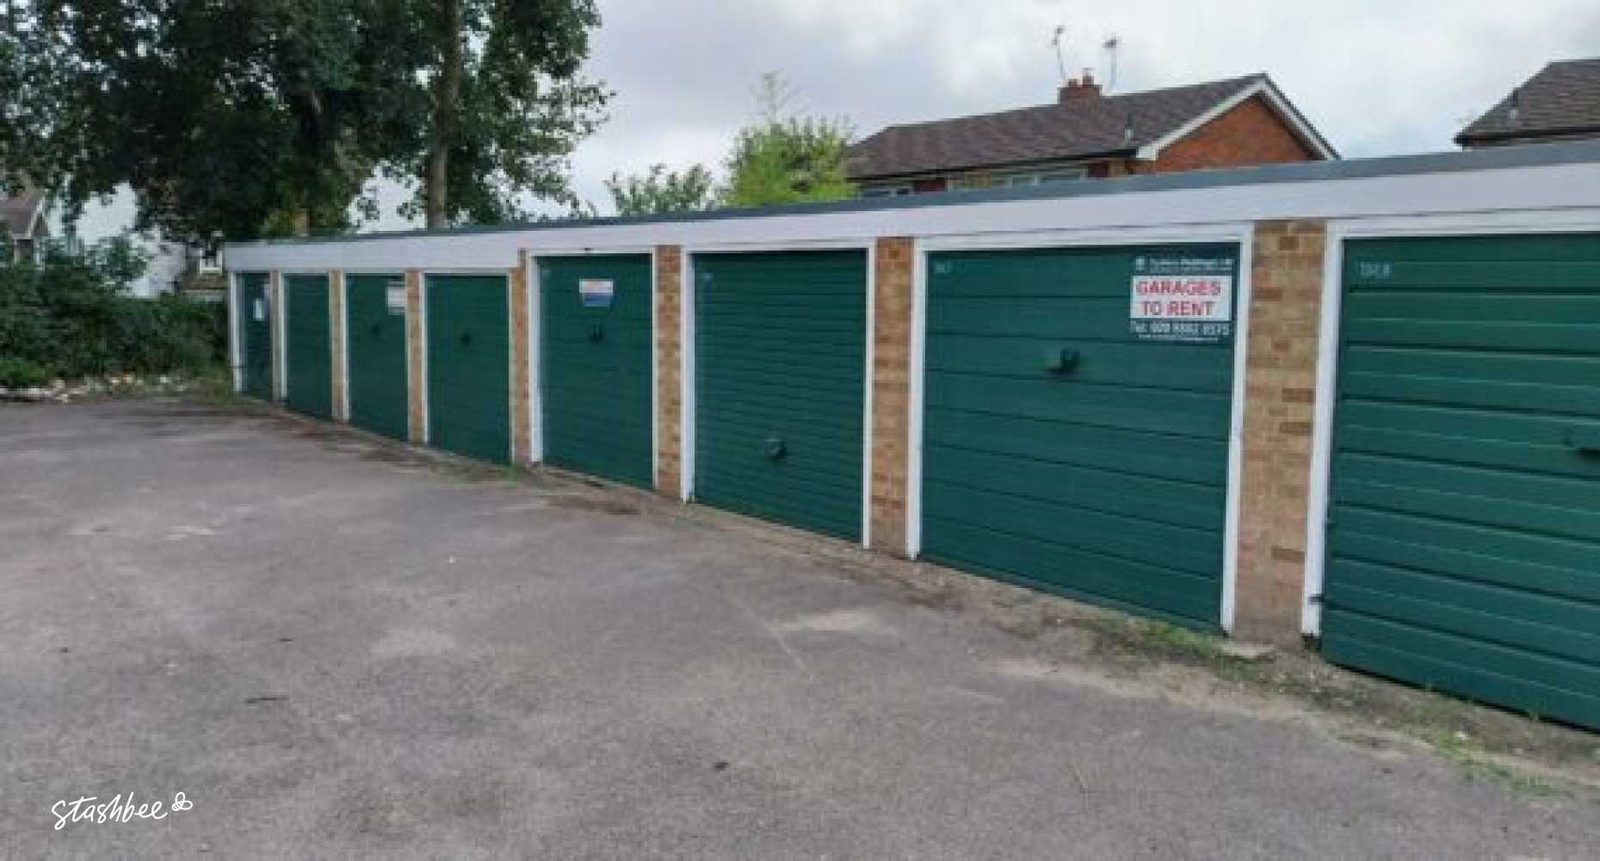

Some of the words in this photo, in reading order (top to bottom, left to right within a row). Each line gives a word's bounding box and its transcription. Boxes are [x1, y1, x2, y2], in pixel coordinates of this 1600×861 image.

[1135, 280, 1222, 296] GARAGES
[1142, 300, 1161, 316] TO
[1166, 300, 1216, 316] RENT
